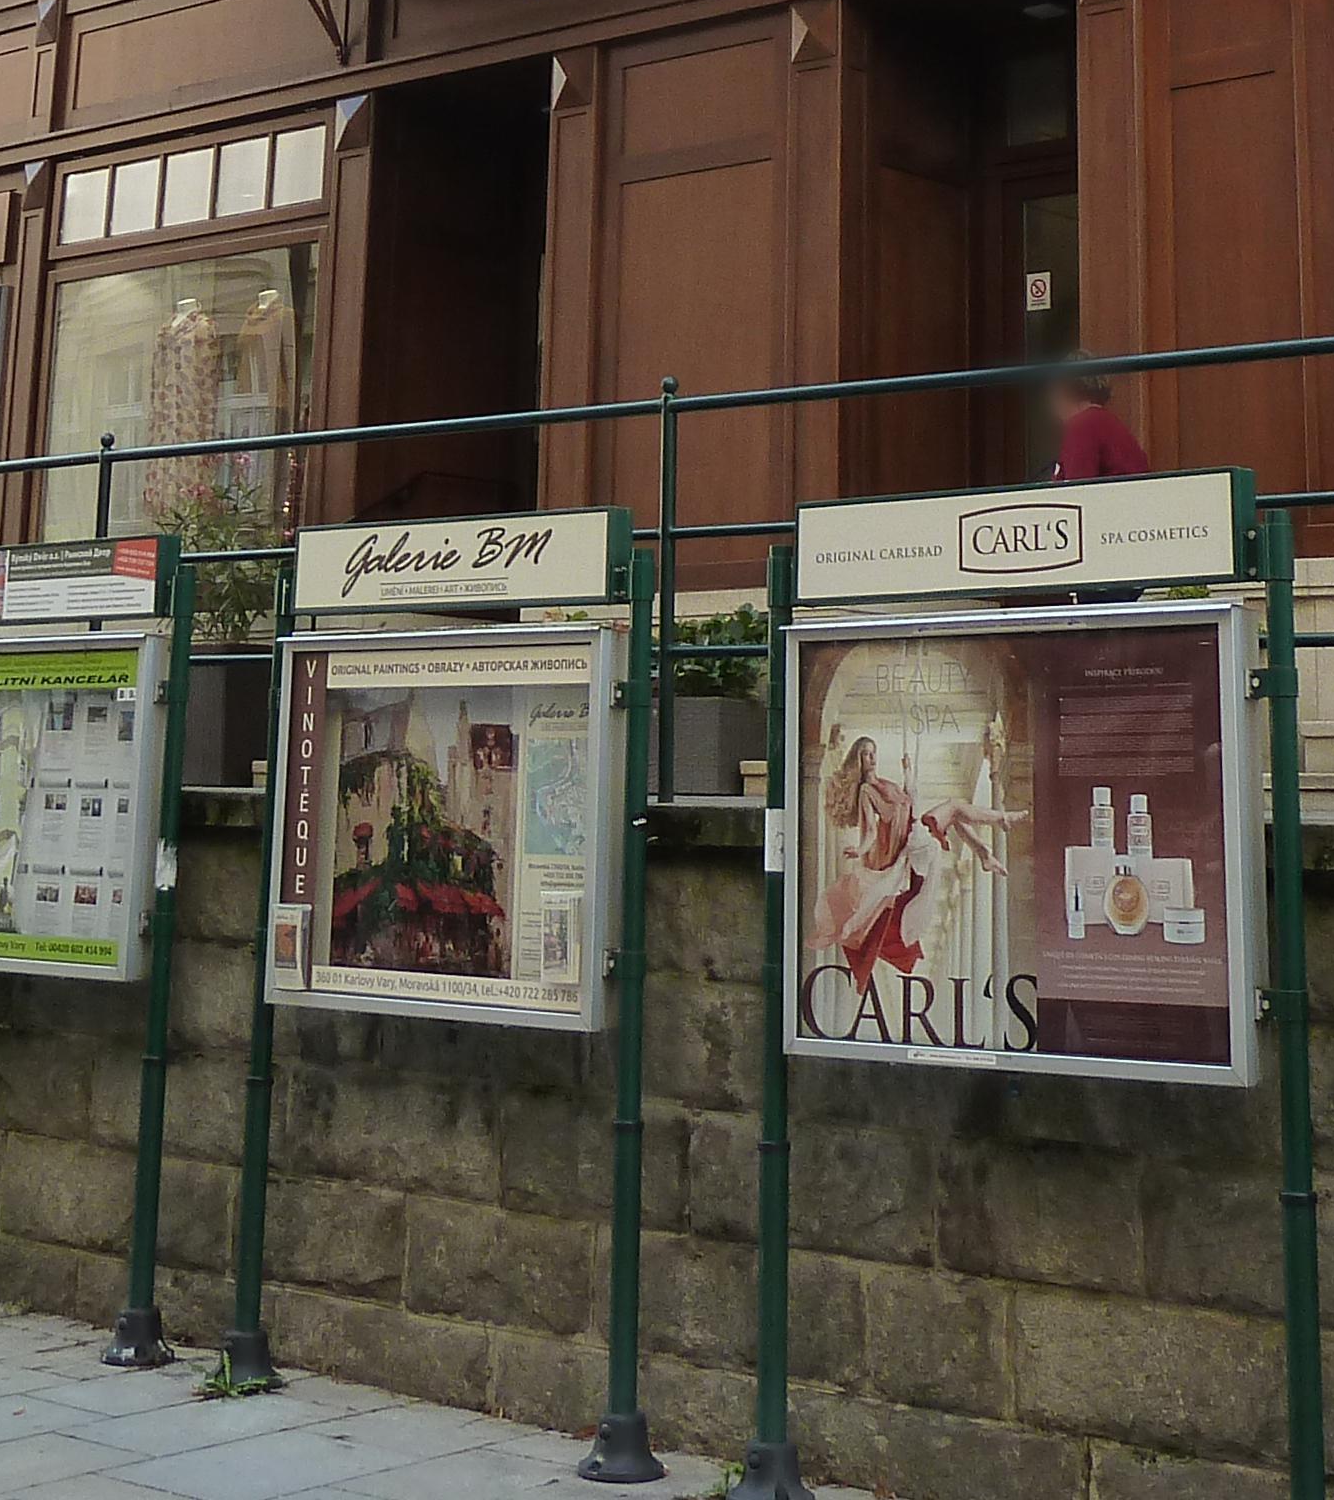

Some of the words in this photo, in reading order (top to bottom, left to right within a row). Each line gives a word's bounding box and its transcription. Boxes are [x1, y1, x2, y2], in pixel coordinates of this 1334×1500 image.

[1101, 530, 1124, 545] SPA
[1128, 525, 1209, 543] COSMETICS
[341, 532, 463, 598] Galerie
[472, 526, 553, 569] BM
[815, 549, 876, 565] ORIGINAL
[879, 545, 943, 560] CARLSBAD
[331, 664, 371, 676] ORIGINAL
[374, 663, 420, 675] PAINTINGS
[427, 662, 463, 674] OBRAZY
[472, 660, 528, 672] АВТОРСКАЯ
[530, 658, 587, 670] ЖИВОПИСЬ
[41, 672, 129, 685] KANCELÁŘ
[876, 661, 970, 693] BEAUTY
[910, 704, 960, 736] SPA
[332, 973, 342, 984] 01
[343, 974, 375, 987] Karlovy
[399, 977, 440, 991] Moravská
[522, 986, 539, 999] 722
